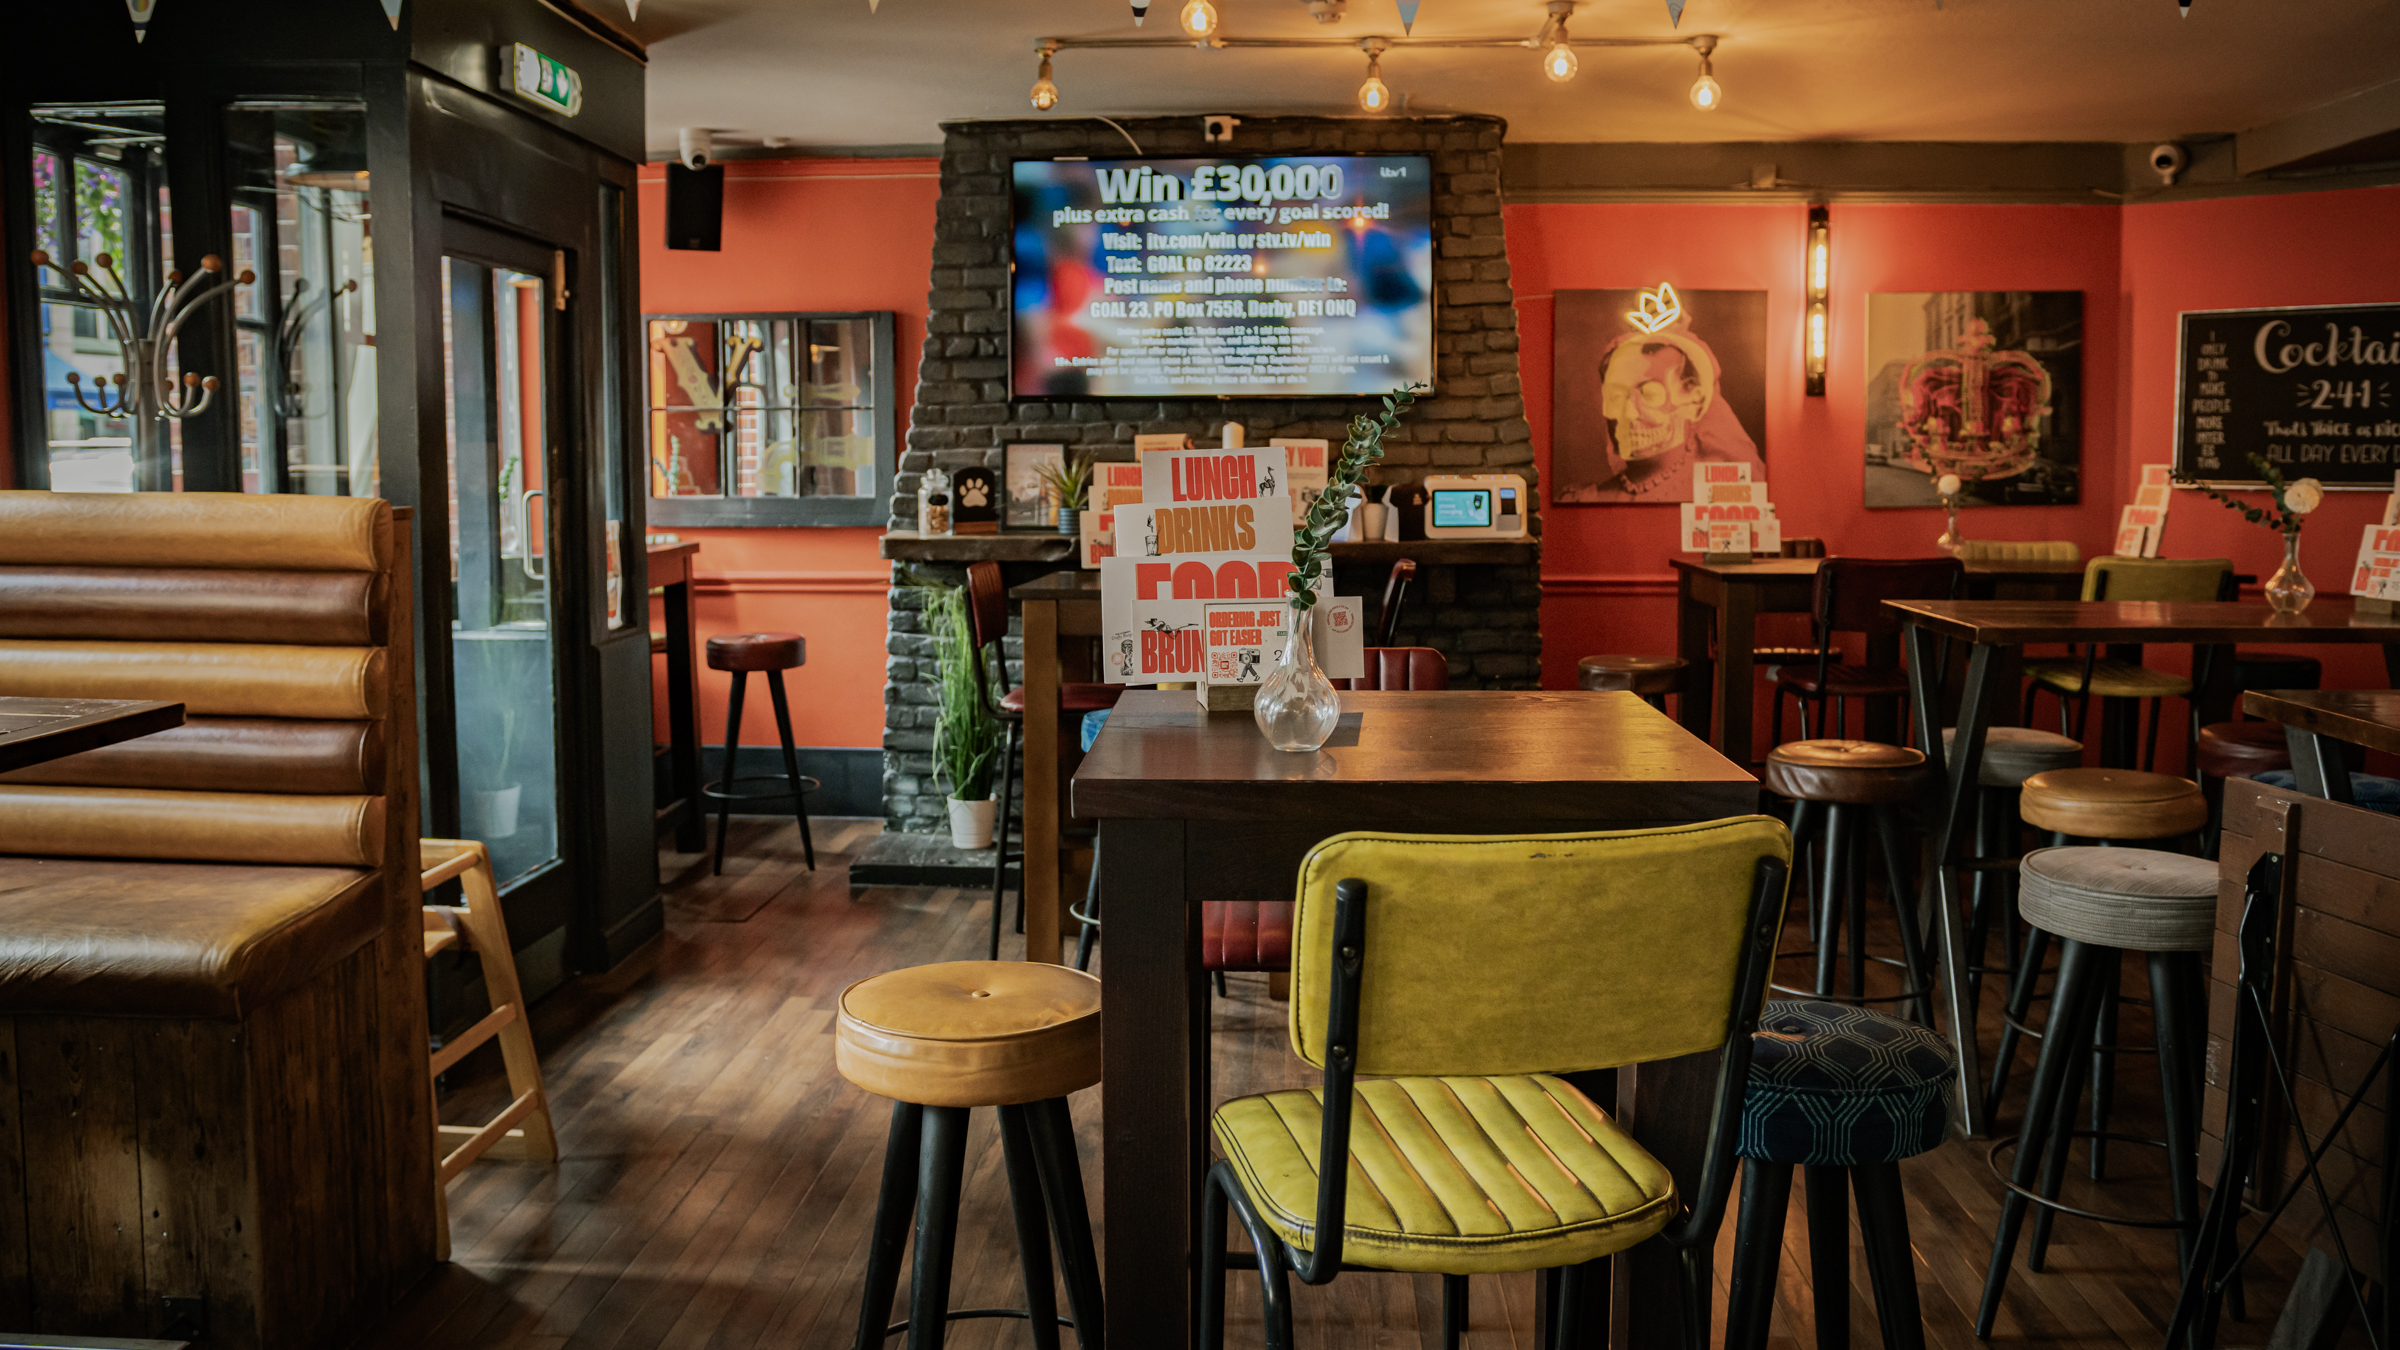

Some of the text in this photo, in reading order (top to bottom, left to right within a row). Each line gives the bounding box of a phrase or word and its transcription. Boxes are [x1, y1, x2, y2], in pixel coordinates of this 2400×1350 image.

[1379, 165, 1407, 179] itv1
[1095, 163, 1344, 208] Win £30,000
[1053, 201, 1390, 228] plus extra cash for every goal scored!
[1102, 230, 1332, 250] Visit: itv.com/win or stv.tv/win
[1105, 254, 1252, 273] Text: GOAL to 82223
[1104, 276, 1348, 296] Post name and phone number to:
[1090, 301, 1127, 318] GOAL
[1128, 301, 1152, 320] 23,
[1153, 301, 1175, 318] PO
[1175, 301, 1205, 318] Box
[1205, 300, 1248, 319] 7558,
[1248, 300, 1296, 319] Derby,
[1297, 299, 1324, 317] DE1
[1171, 454, 1258, 502] LUNCH
[1155, 503, 1257, 555] DRINKS
[1208, 610, 1256, 628] ORDERING
[1256, 609, 1281, 627] JUST
[1209, 628, 1262, 647] GOT EASIER
